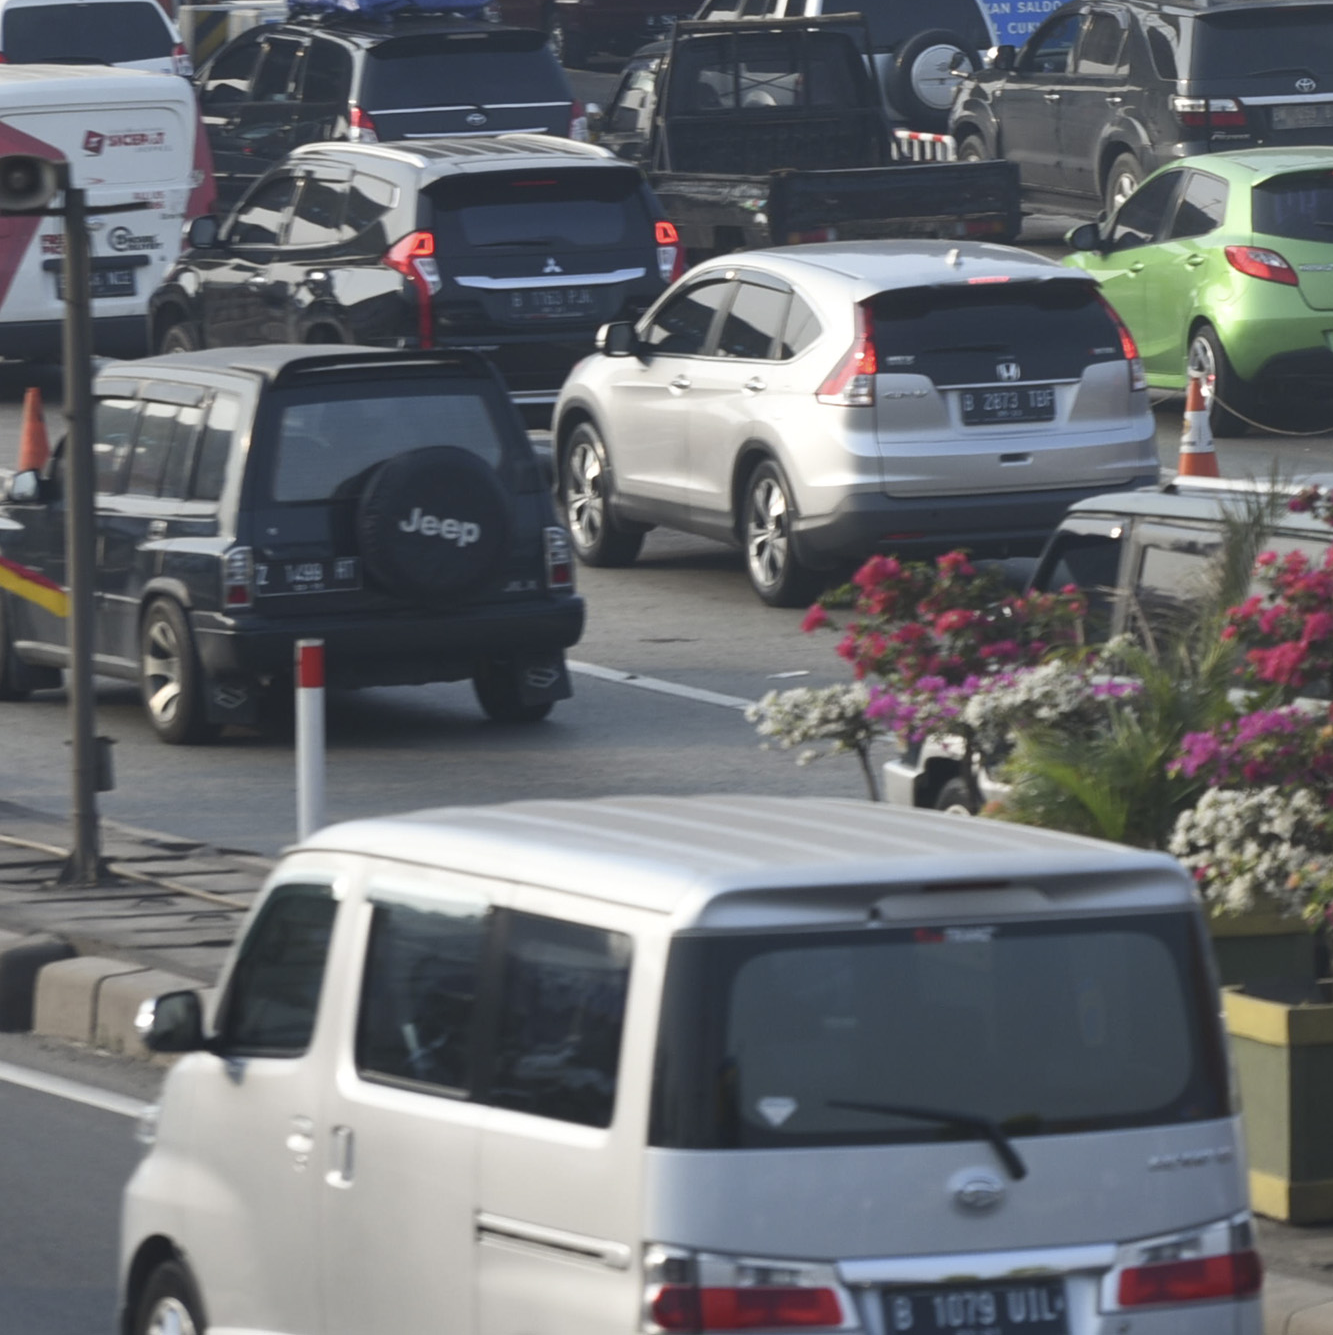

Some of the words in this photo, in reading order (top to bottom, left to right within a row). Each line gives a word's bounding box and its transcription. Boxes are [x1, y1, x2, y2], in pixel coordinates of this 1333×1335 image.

[963, 392, 974, 411] B
[400, 507, 481, 547] Jeep
[892, 1294, 915, 1332] B
